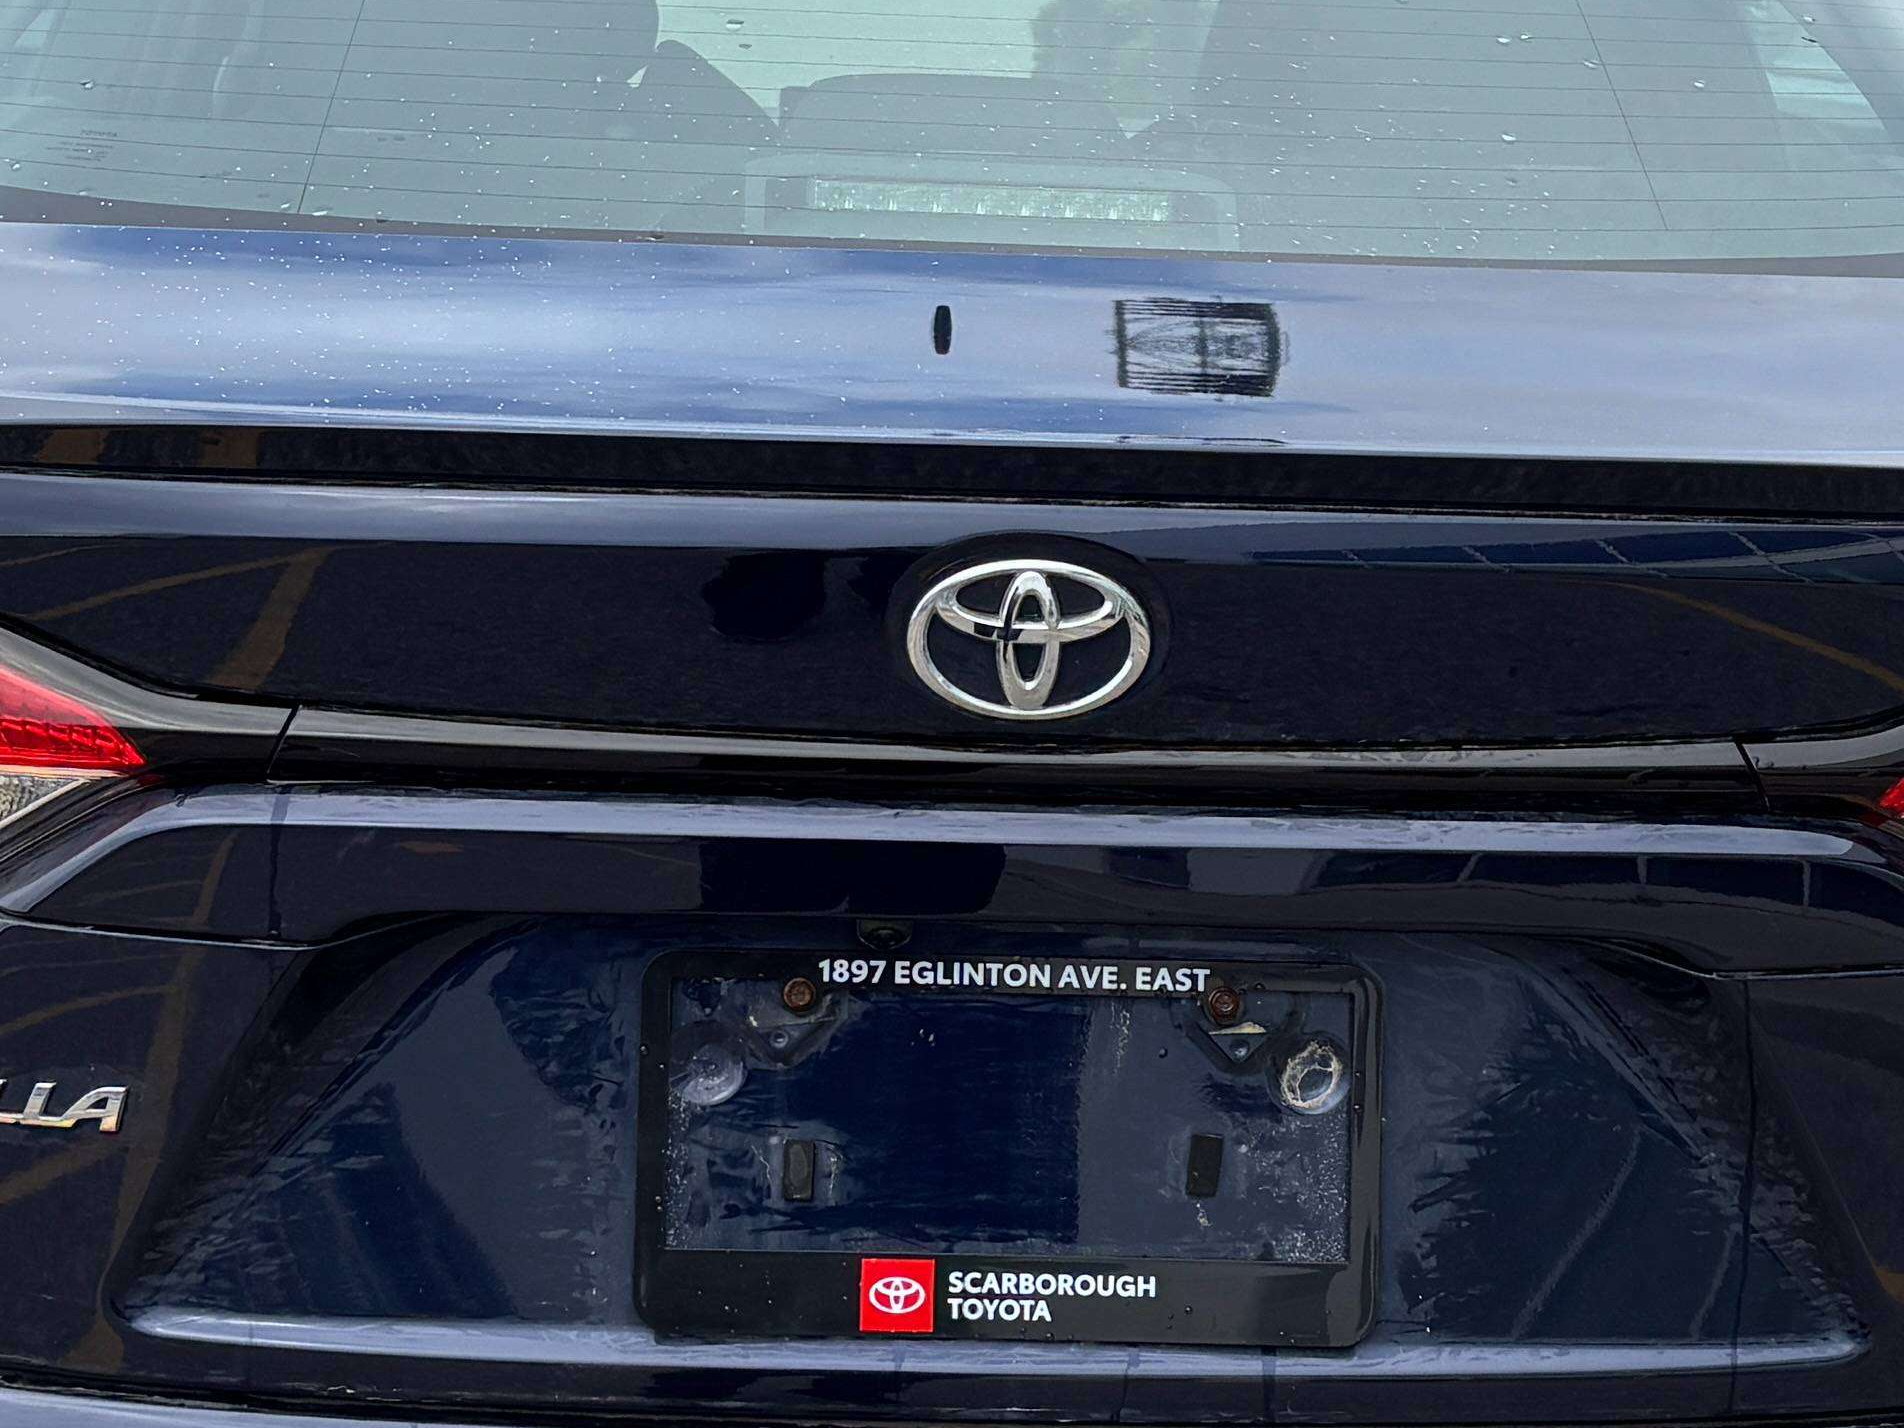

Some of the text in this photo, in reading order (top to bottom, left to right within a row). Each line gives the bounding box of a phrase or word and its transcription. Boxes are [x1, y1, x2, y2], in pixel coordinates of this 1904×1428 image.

[818, 958, 1211, 993] 1897 EGLINTON AVE. EAST
[947, 1271, 1157, 1299] SCARBOROUGH
[947, 1297, 1052, 1322] TOYOTA
